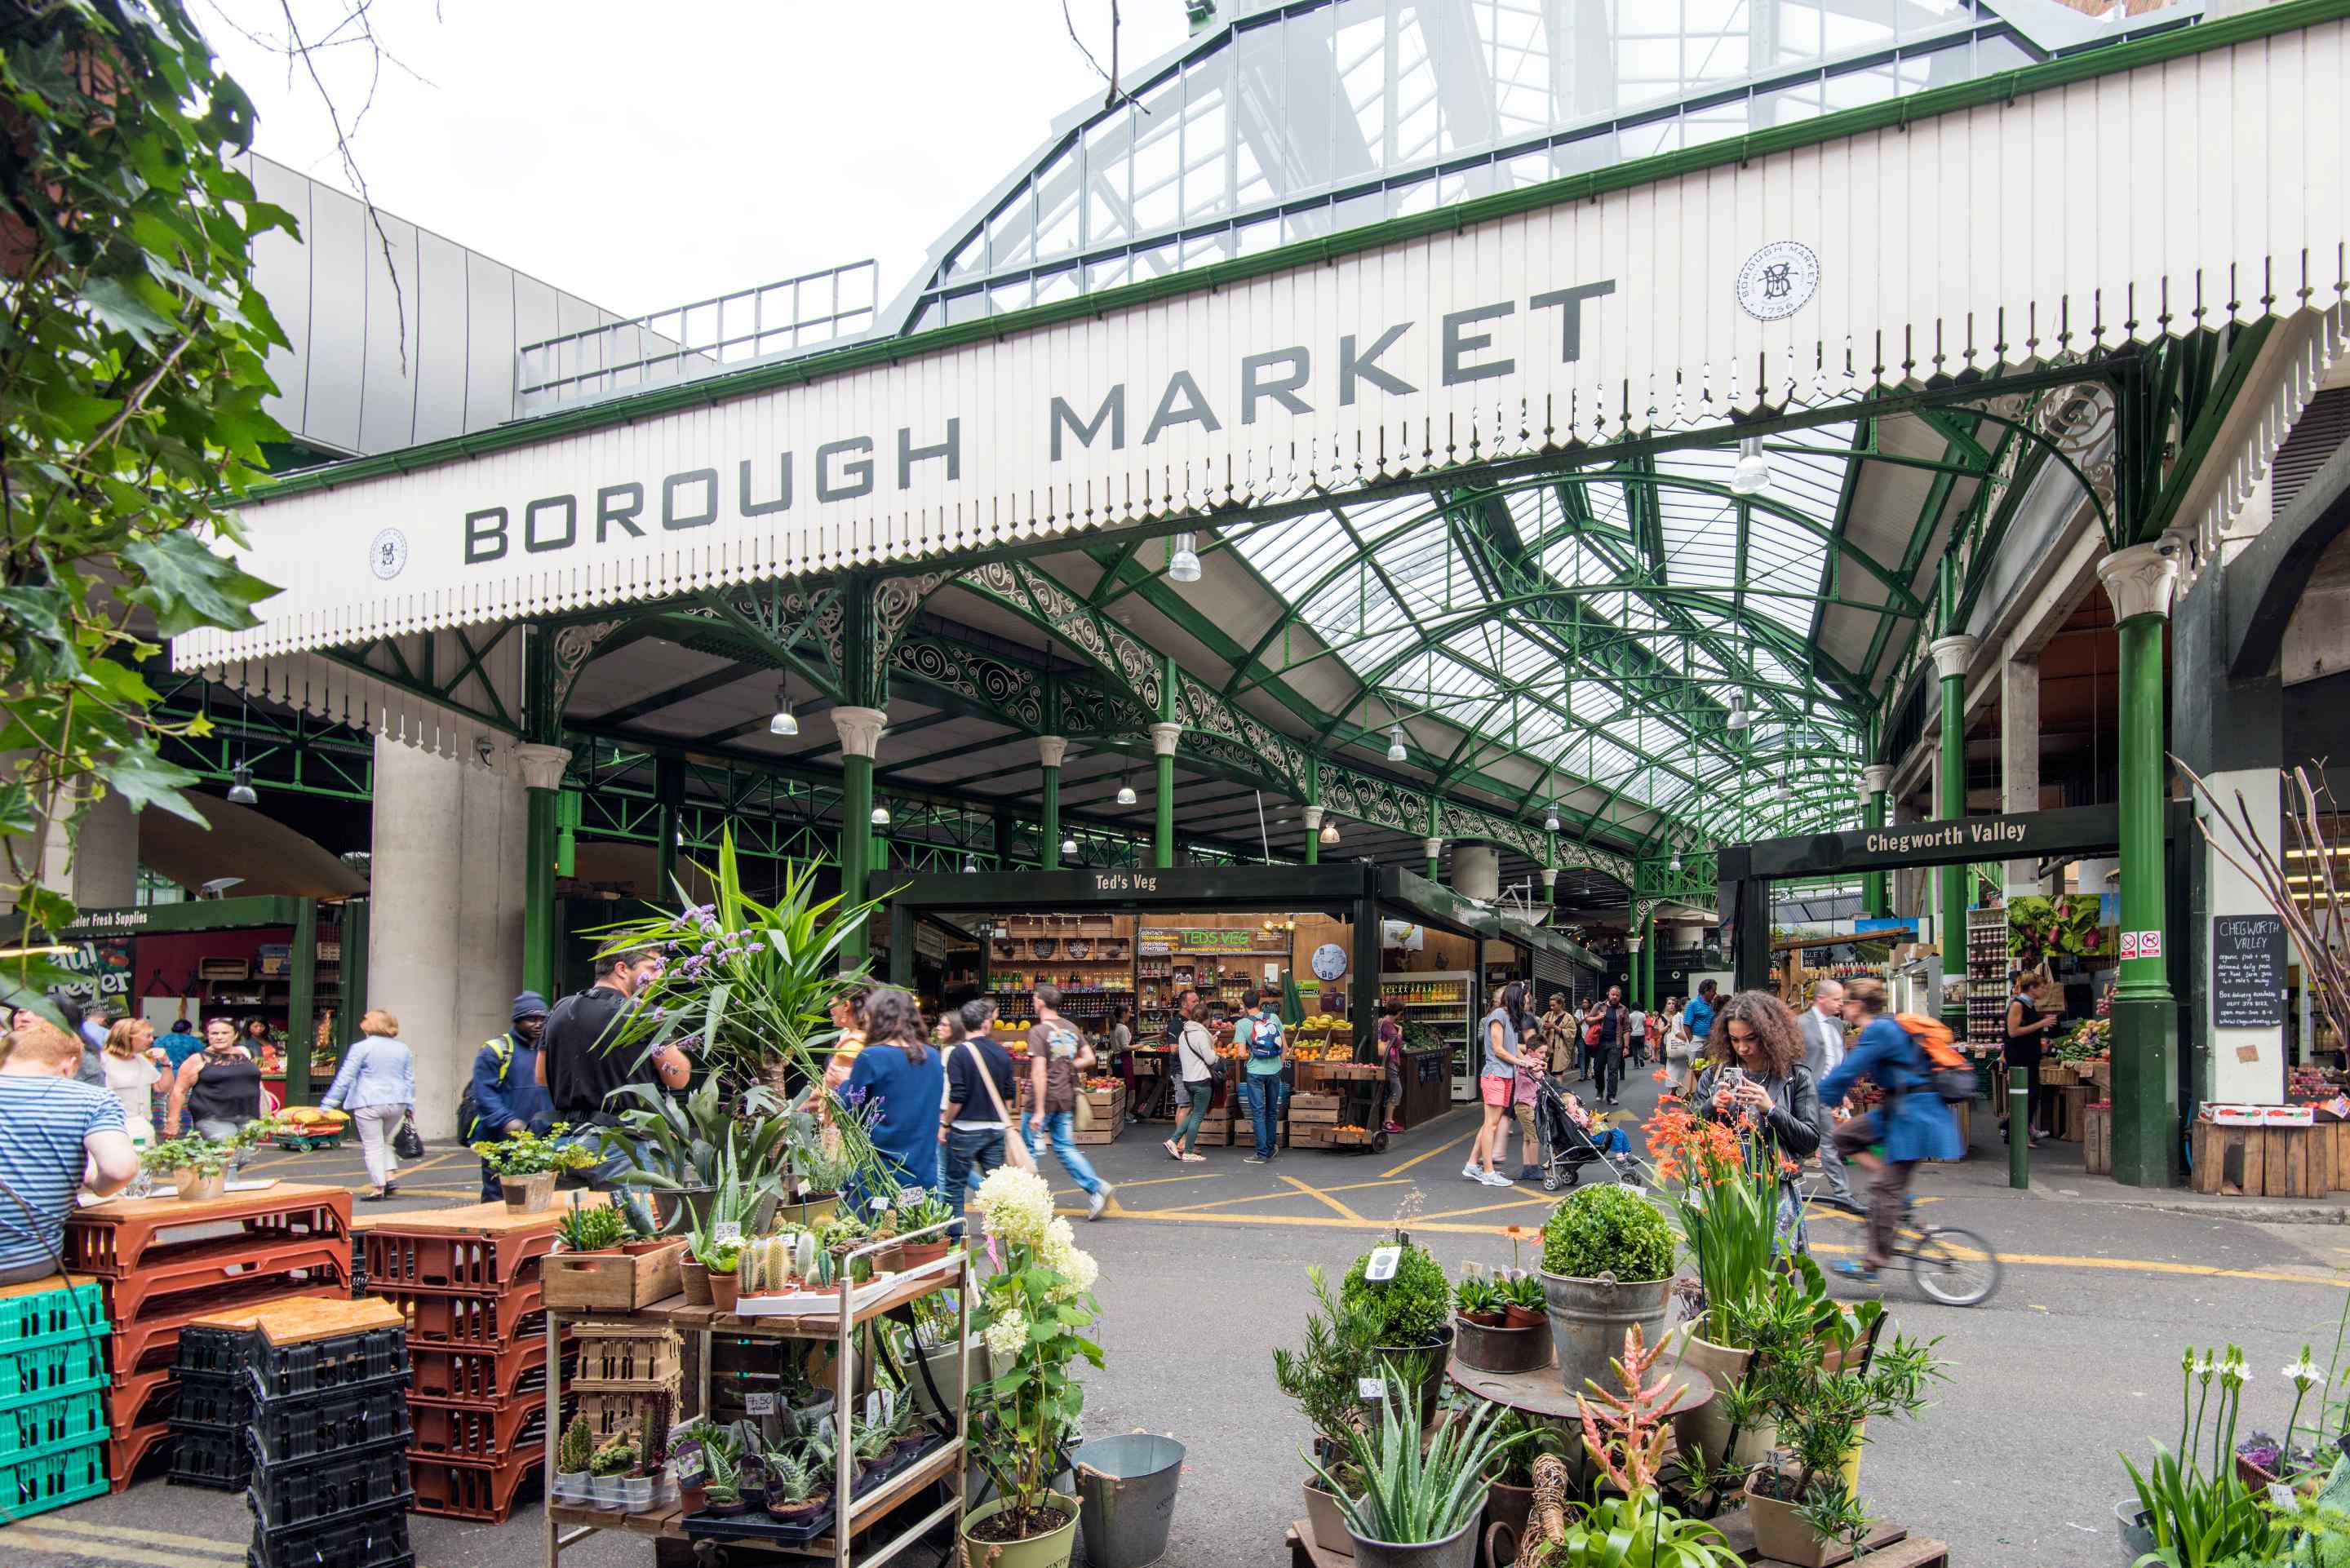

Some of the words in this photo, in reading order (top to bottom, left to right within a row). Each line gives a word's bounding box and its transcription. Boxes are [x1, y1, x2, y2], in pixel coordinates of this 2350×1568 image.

[465, 417, 960, 565] BOROUGH
[1050, 279, 1616, 462] MARKET
[1867, 826, 1962, 853] Chegworth
[1971, 822, 2026, 843] Valley
[1096, 875, 1128, 889] Ted's
[1133, 874, 1156, 891] Veg
[92, 912, 113, 927] Fresh
[115, 910, 148, 927] Supplies
[2219, 920, 2280, 936] CHEGWORTH
[1221, 931, 1249, 945] VEG
[2235, 937, 2267, 950] VALLEY
[47, 941, 98, 970] aul
[2242, 963, 2255, 972] daily
[2219, 990, 2230, 999] Box
